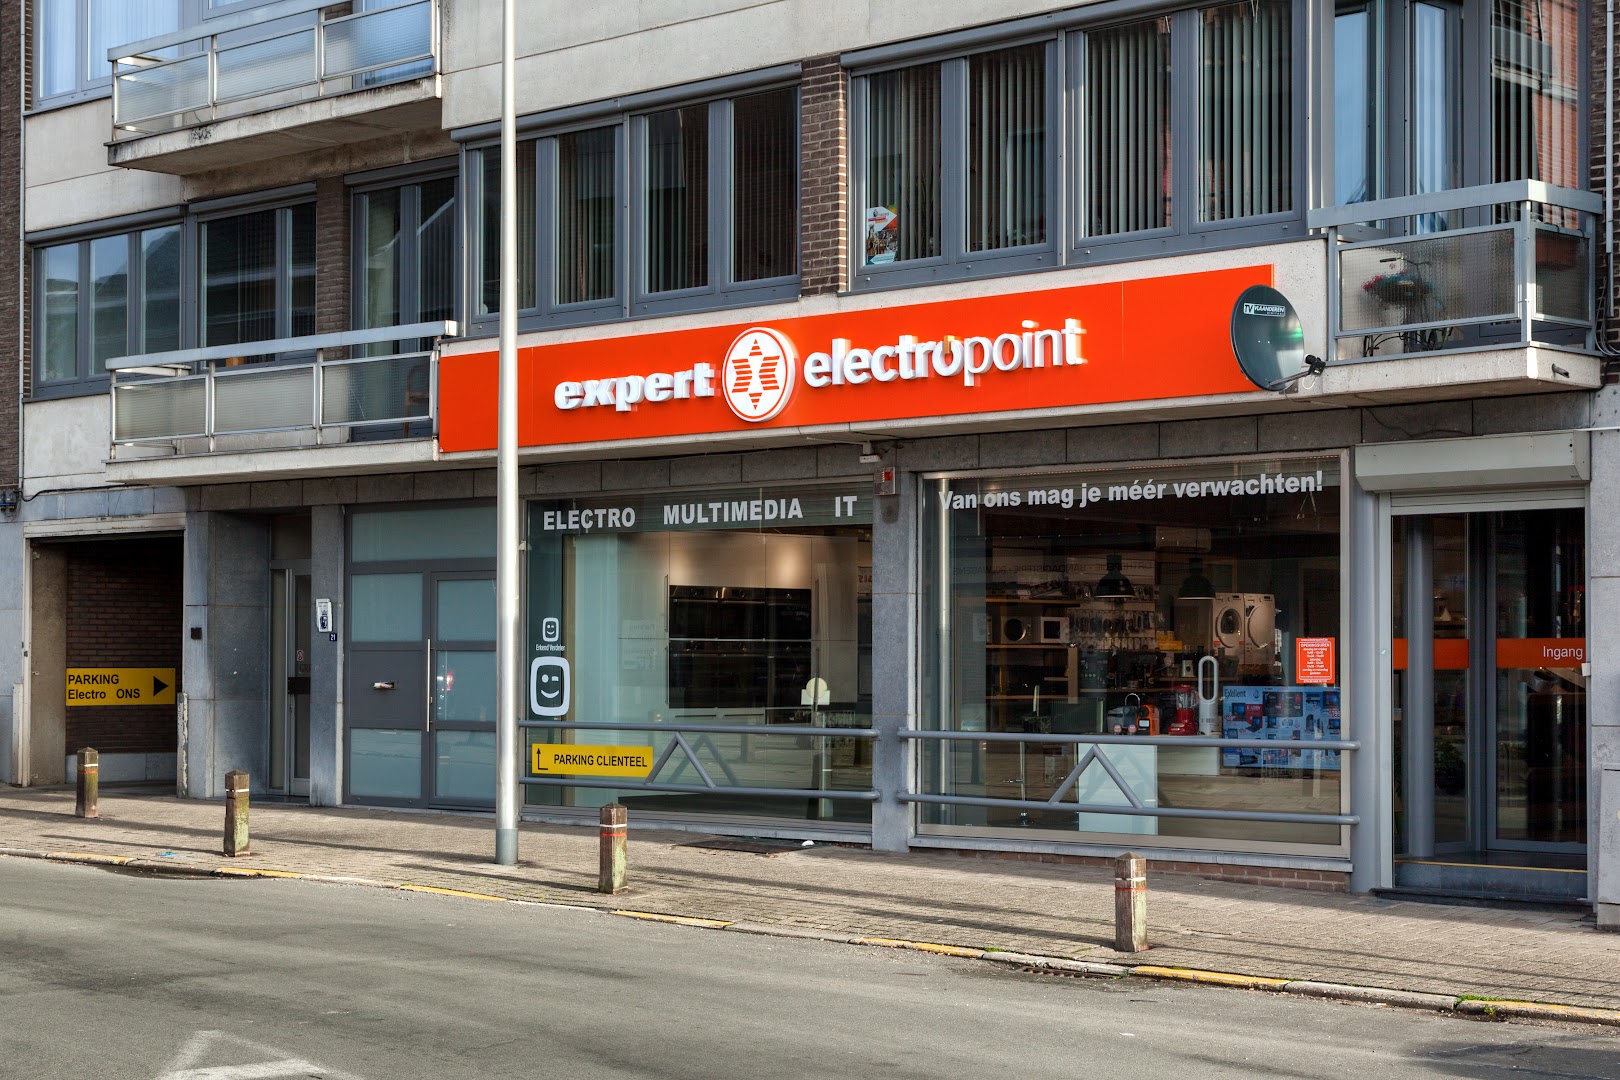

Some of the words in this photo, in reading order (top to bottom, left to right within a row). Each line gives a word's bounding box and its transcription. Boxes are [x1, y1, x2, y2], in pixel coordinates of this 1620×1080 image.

[1244, 304, 1253, 313] TV
[554, 362, 715, 411] expert
[803, 318, 1085, 388] electropoint
[938, 490, 977, 510] Van
[983, 491, 1021, 508] ons
[1028, 488, 1074, 509] mag
[1079, 483, 1102, 508] je
[1108, 478, 1167, 501] méér
[1173, 470, 1323, 499] verwachten!
[543, 507, 636, 531] ELECTRO
[664, 497, 803, 525] MULTIMEDIA
[834, 495, 858, 518] IT
[330, 633, 336, 641] 21
[1543, 645, 1583, 661] Ingang
[67, 674, 119, 685] PARKING
[67, 689, 106, 700] Electro
[116, 688, 140, 699] ONS
[553, 753, 594, 766] PARKING
[596, 755, 648, 768] CLIENTEEL
